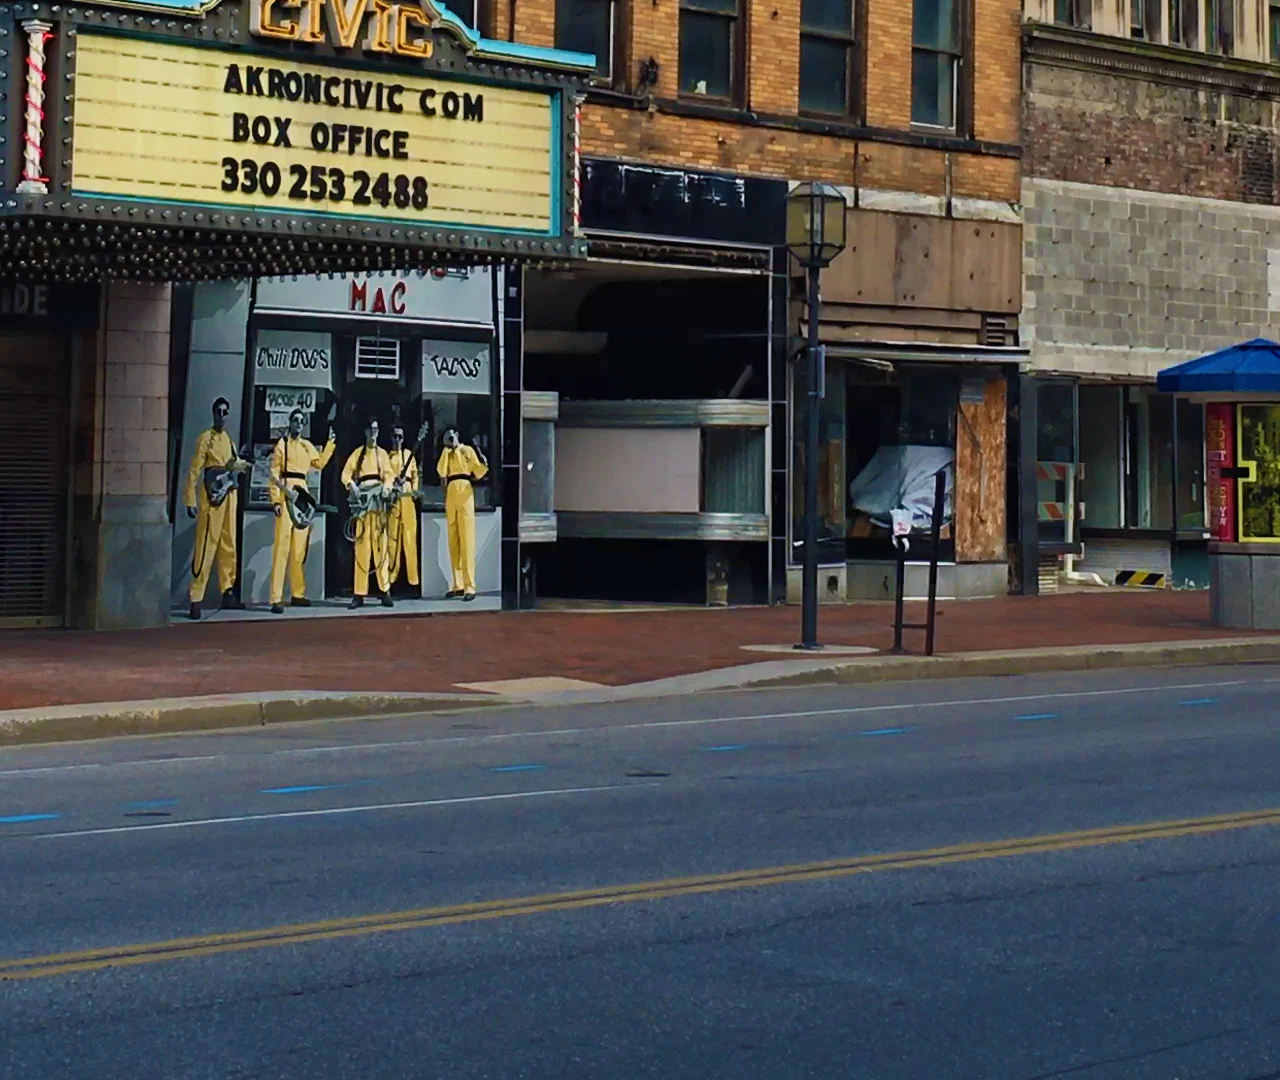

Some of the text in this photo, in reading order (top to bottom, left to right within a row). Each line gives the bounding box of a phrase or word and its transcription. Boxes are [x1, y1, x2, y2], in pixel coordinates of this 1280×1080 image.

[223, 63, 485, 122] AKRONCIVIC COM
[231, 112, 410, 160] BOX OFFICE
[221, 156, 430, 211] 330 253 2488
[429, 353, 481, 380] TACOS
[296, 392, 313, 409] 40
